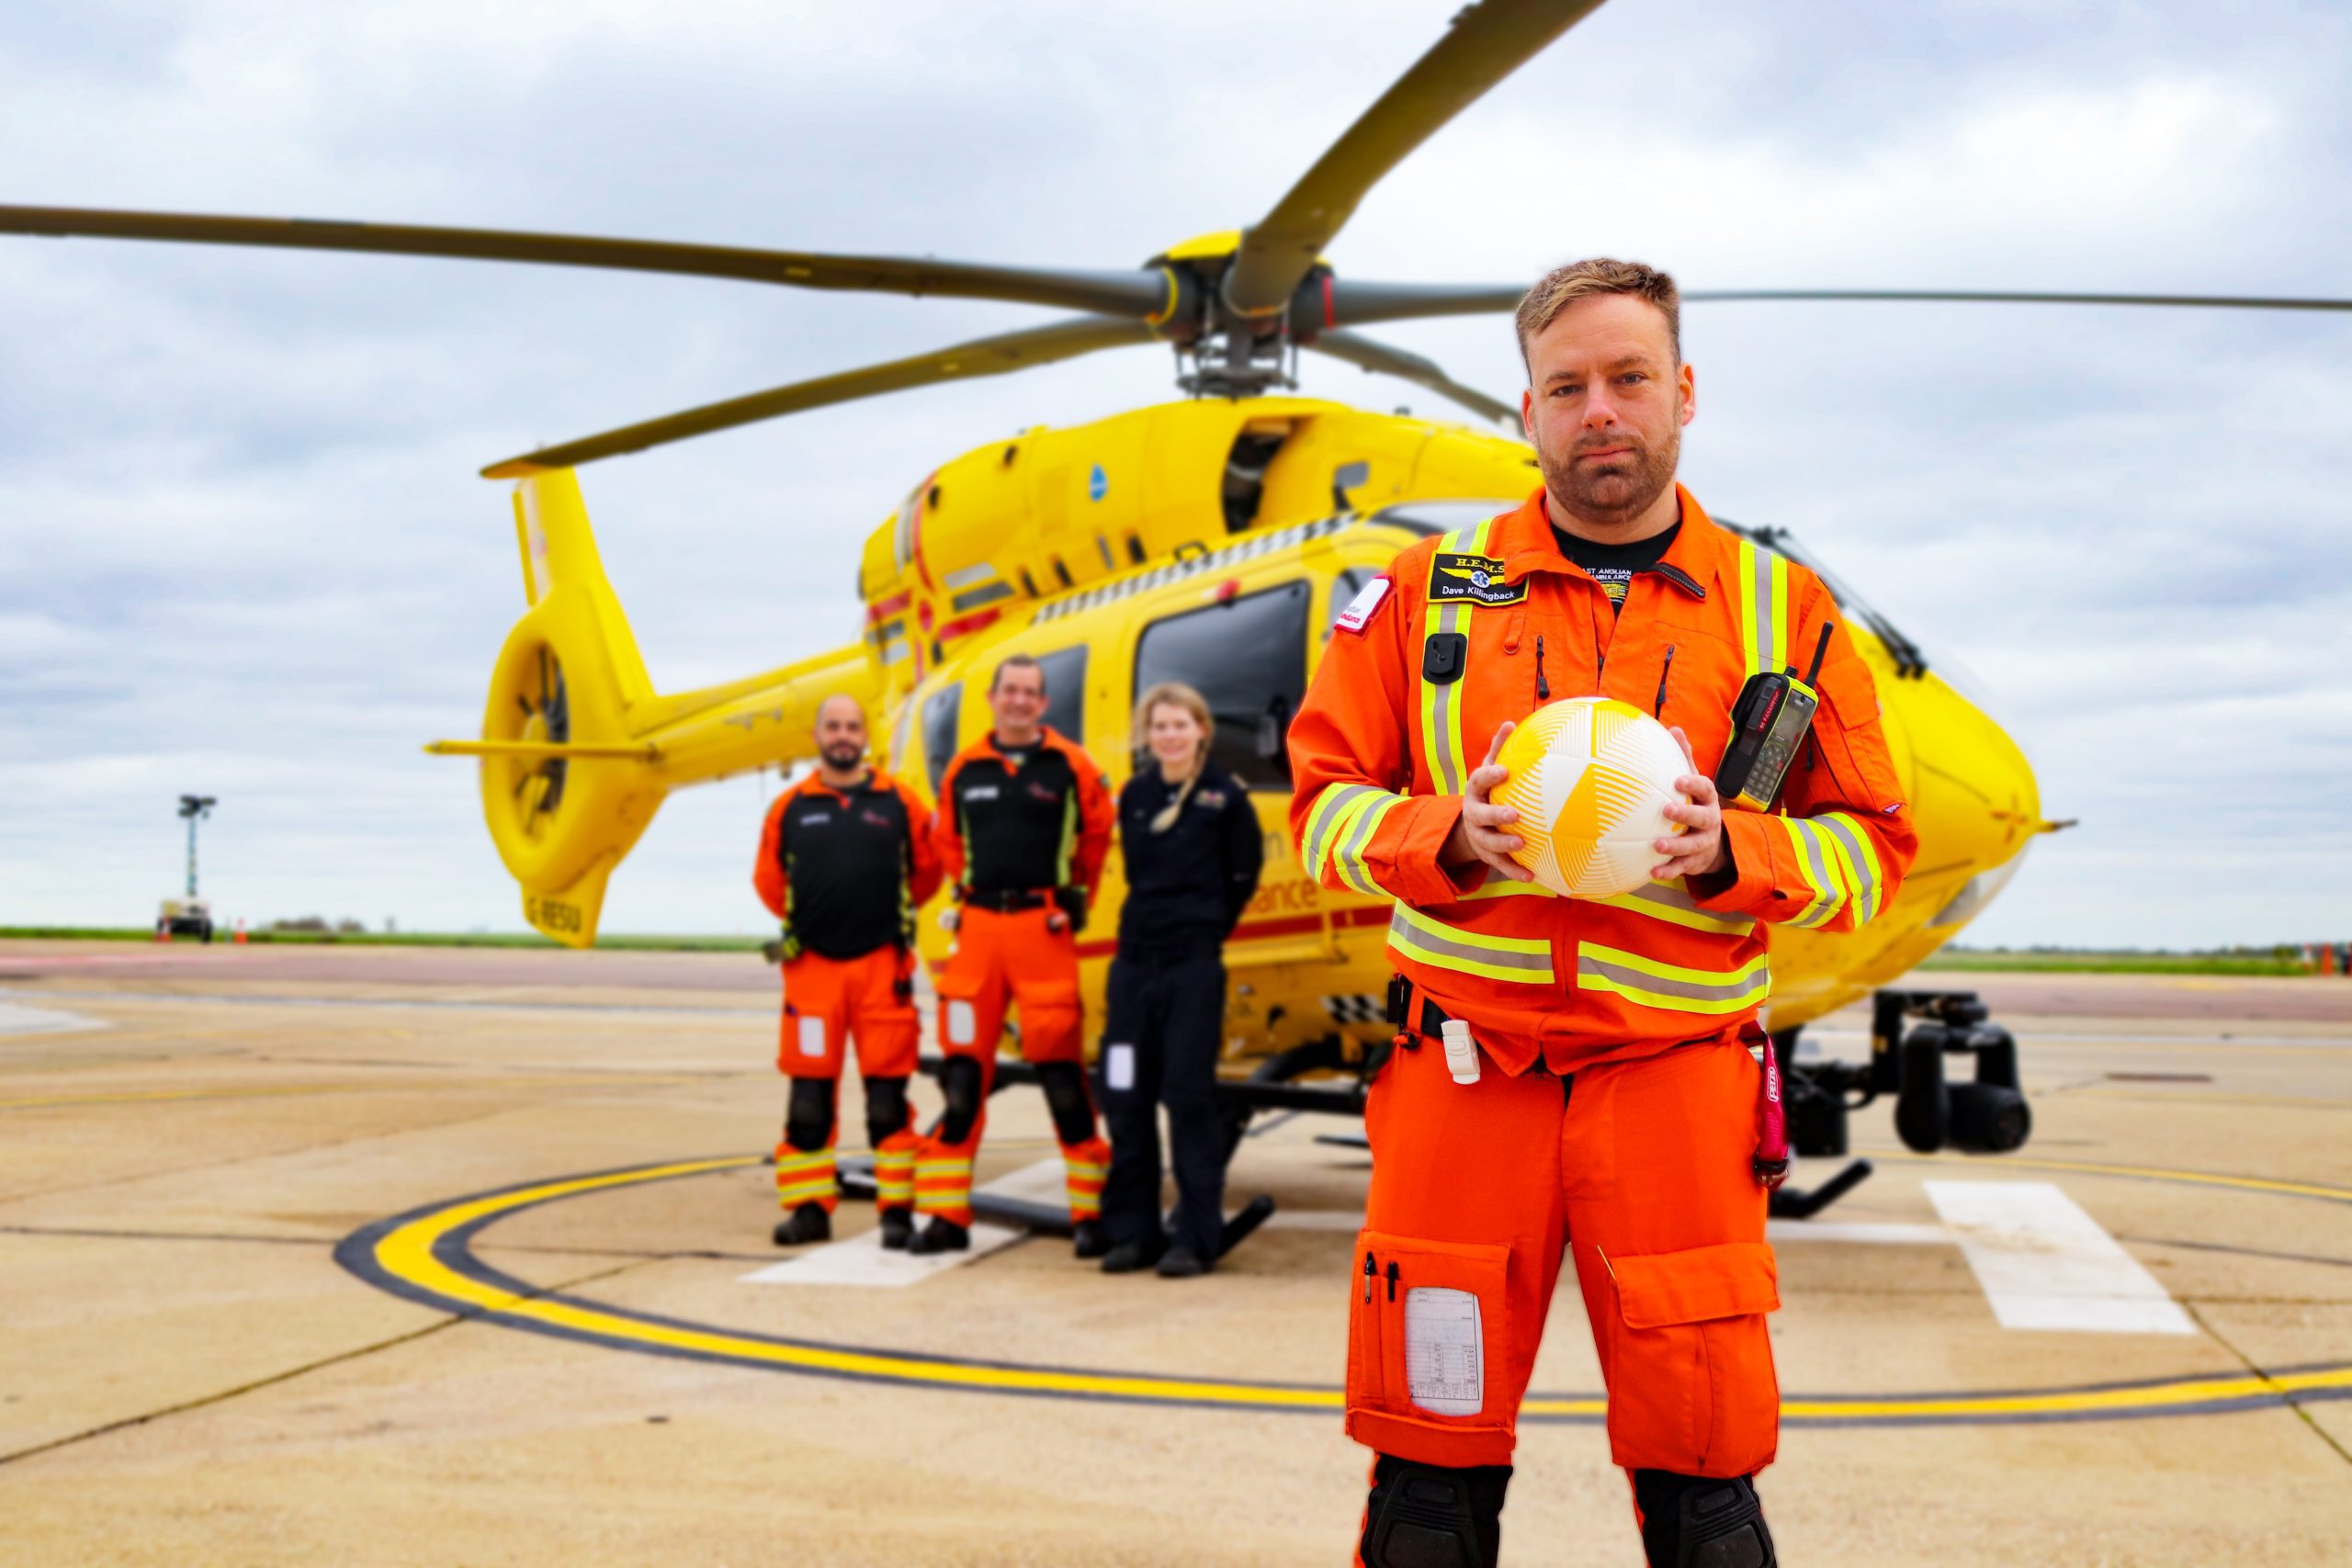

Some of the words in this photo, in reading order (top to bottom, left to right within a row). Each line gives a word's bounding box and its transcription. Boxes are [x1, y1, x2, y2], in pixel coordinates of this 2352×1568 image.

[1599, 568, 1632, 576] ANGLIAN
[1442, 585, 1464, 595] Dave
[1467, 586, 1515, 602] Killingback
